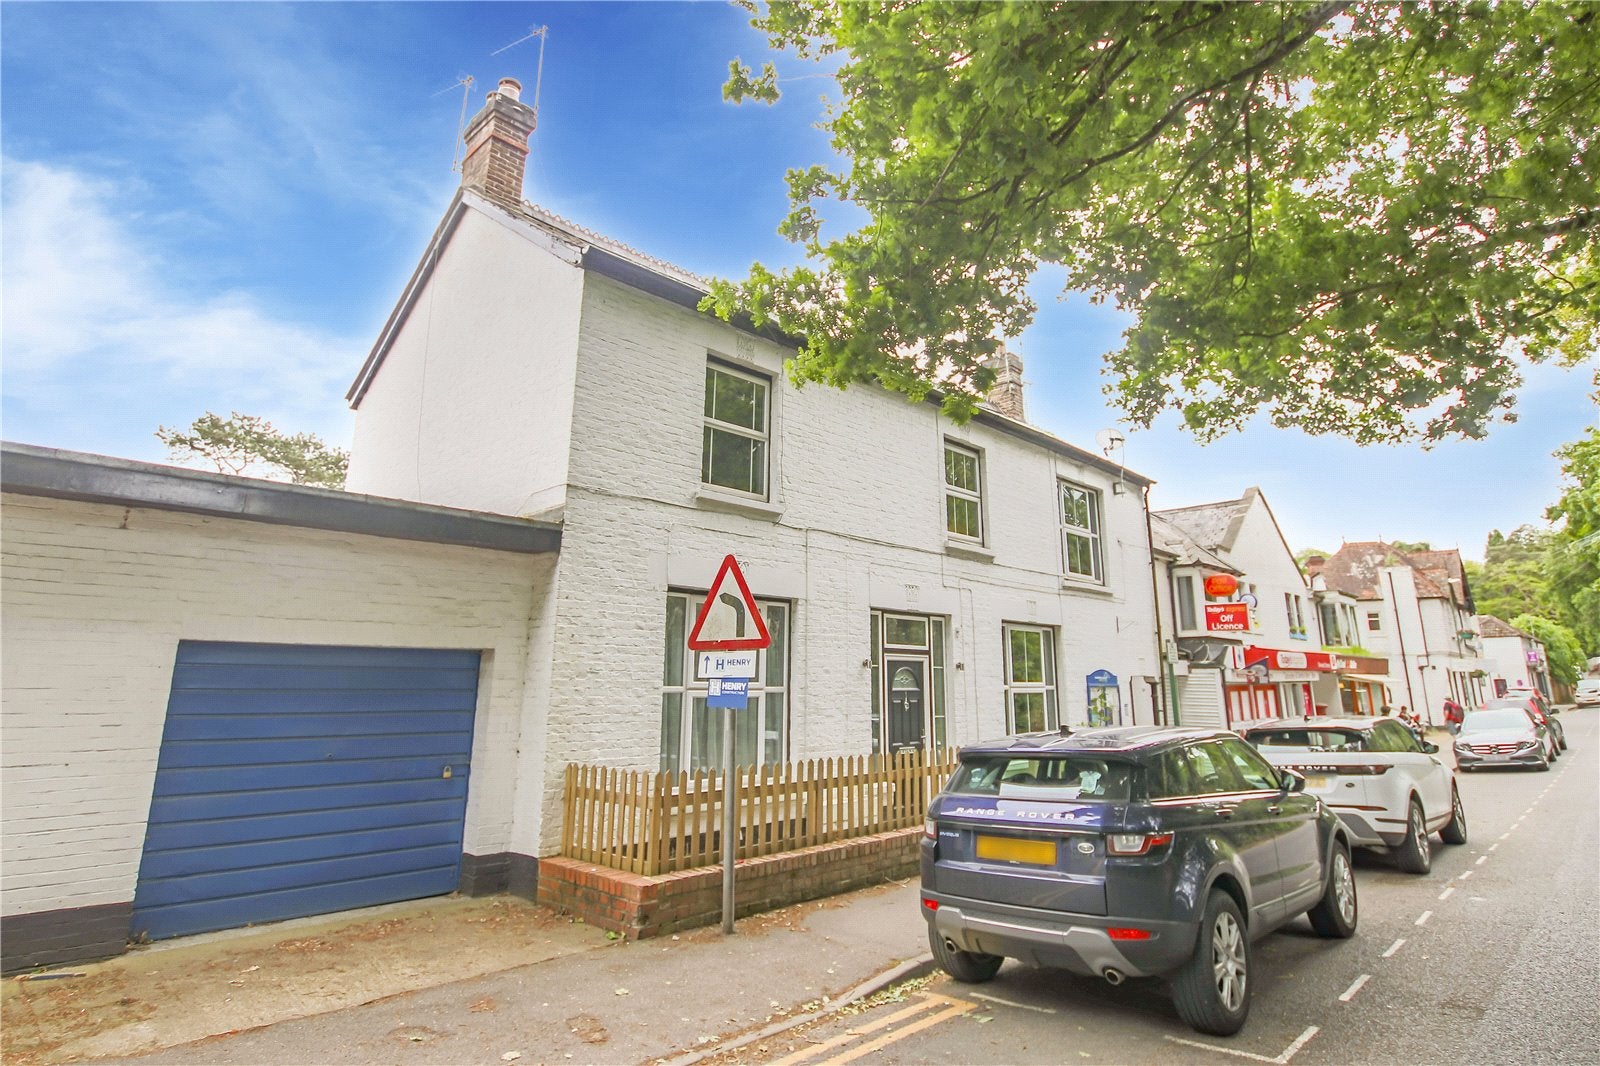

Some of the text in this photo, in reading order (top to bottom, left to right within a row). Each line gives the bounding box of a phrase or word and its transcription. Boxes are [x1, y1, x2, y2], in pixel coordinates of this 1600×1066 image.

[1220, 614, 1234, 623] Off
[1211, 622, 1244, 631] Licence
[721, 681, 746, 690] HENRY
[955, 806, 1076, 820] RANGE ROVER
